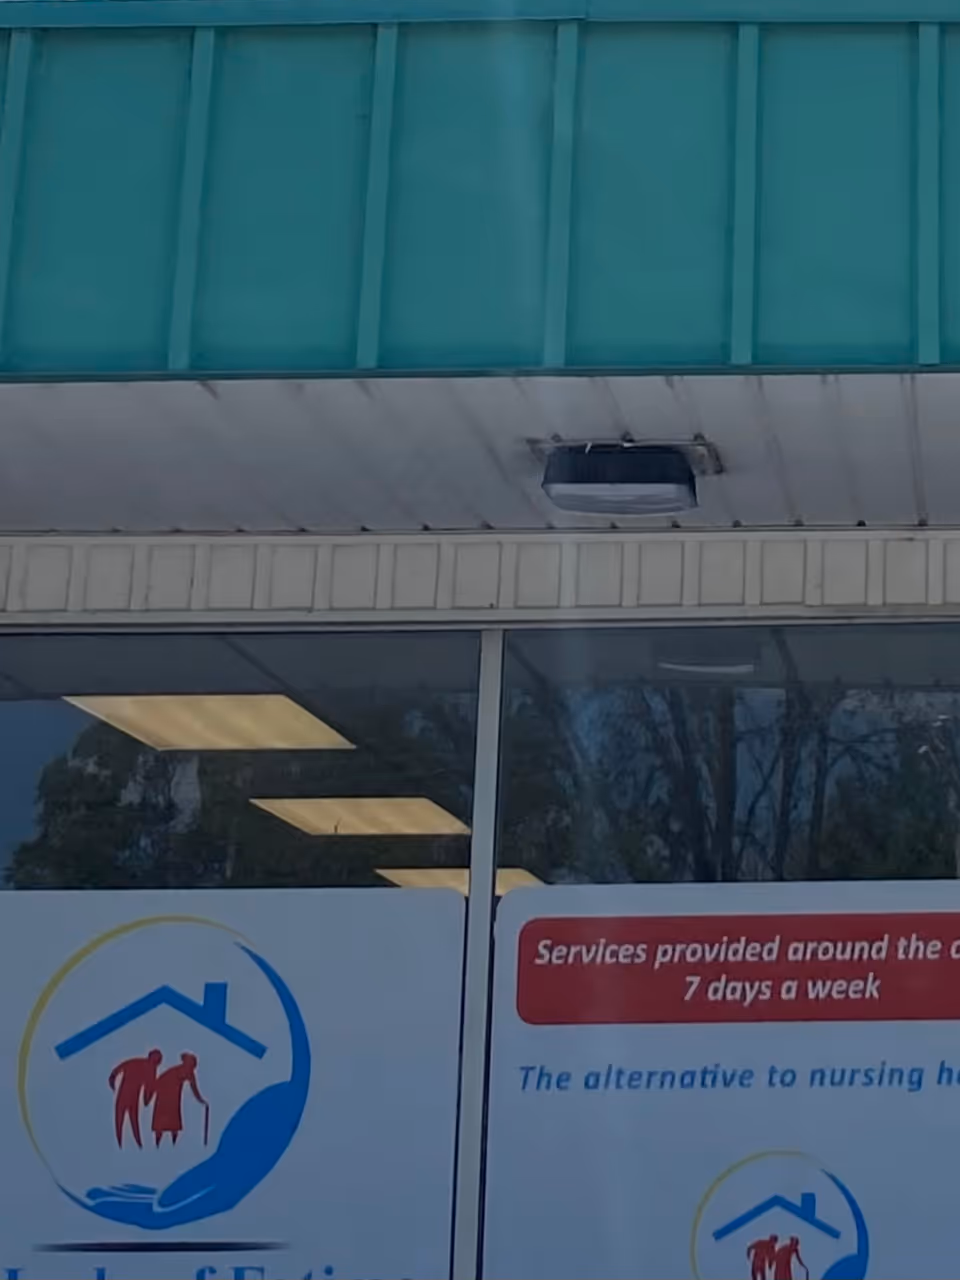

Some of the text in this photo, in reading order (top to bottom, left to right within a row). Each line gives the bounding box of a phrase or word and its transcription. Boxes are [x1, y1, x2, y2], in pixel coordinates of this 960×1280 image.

[534, 938, 648, 965] Services
[654, 935, 780, 969] provided
[788, 933, 889, 961] around
[897, 932, 942, 960] the
[684, 972, 881, 1007] 7 days a week
[519, 1065, 572, 1091] The
[584, 1063, 754, 1091] alternative
[768, 1065, 797, 1089] to
[809, 1060, 925, 1093] nursing
